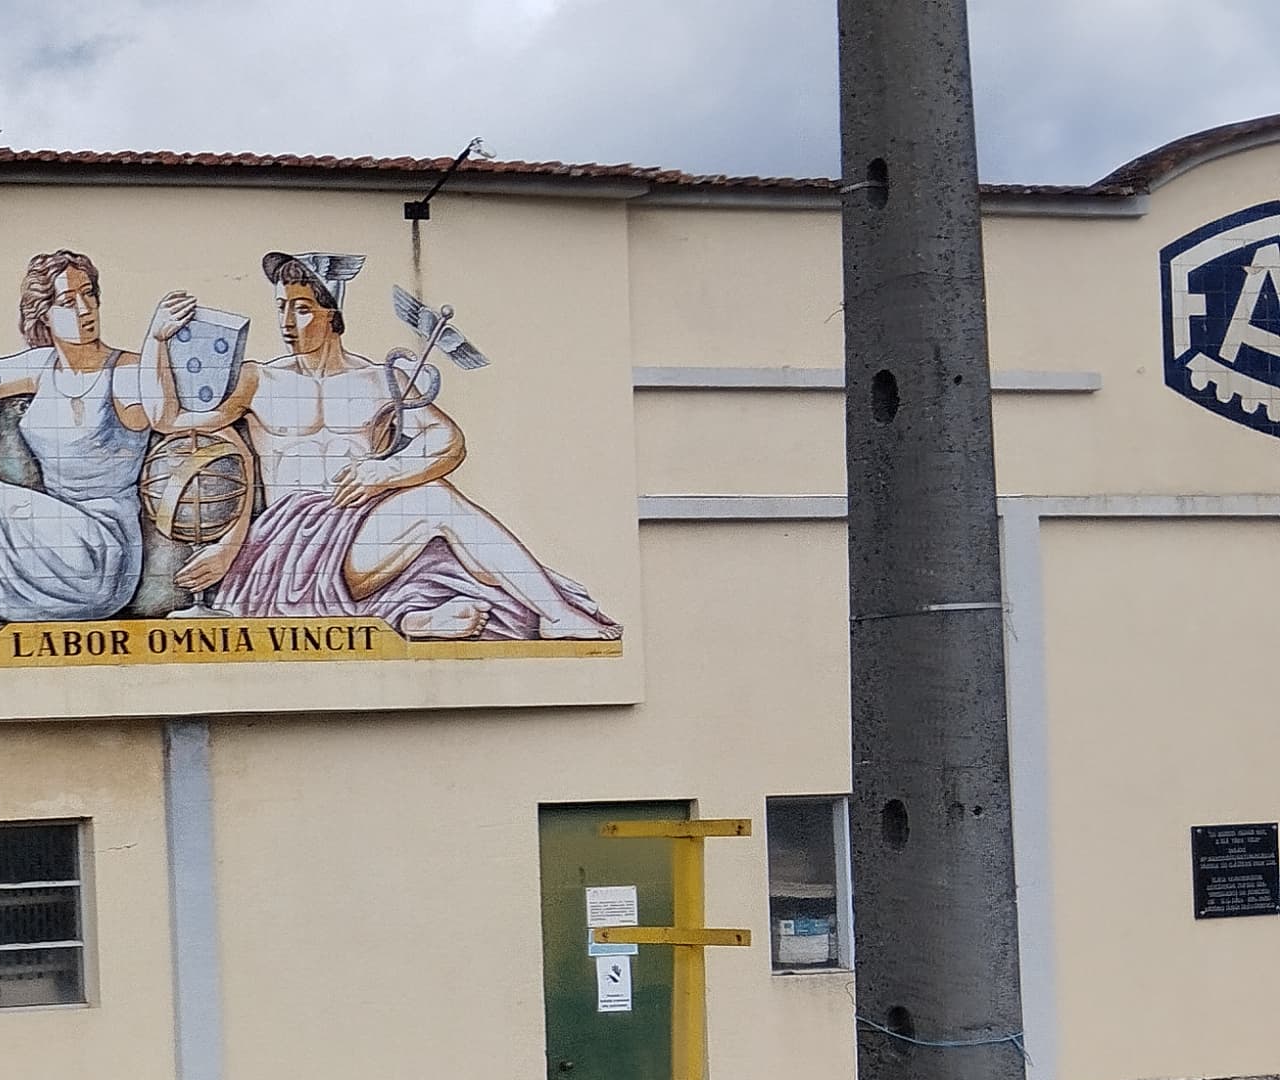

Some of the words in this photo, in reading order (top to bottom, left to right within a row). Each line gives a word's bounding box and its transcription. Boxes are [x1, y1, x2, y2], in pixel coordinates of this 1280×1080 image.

[12, 629, 132, 658] LABOR
[147, 627, 254, 654] OMNIA
[267, 625, 378, 652] VINCIT
